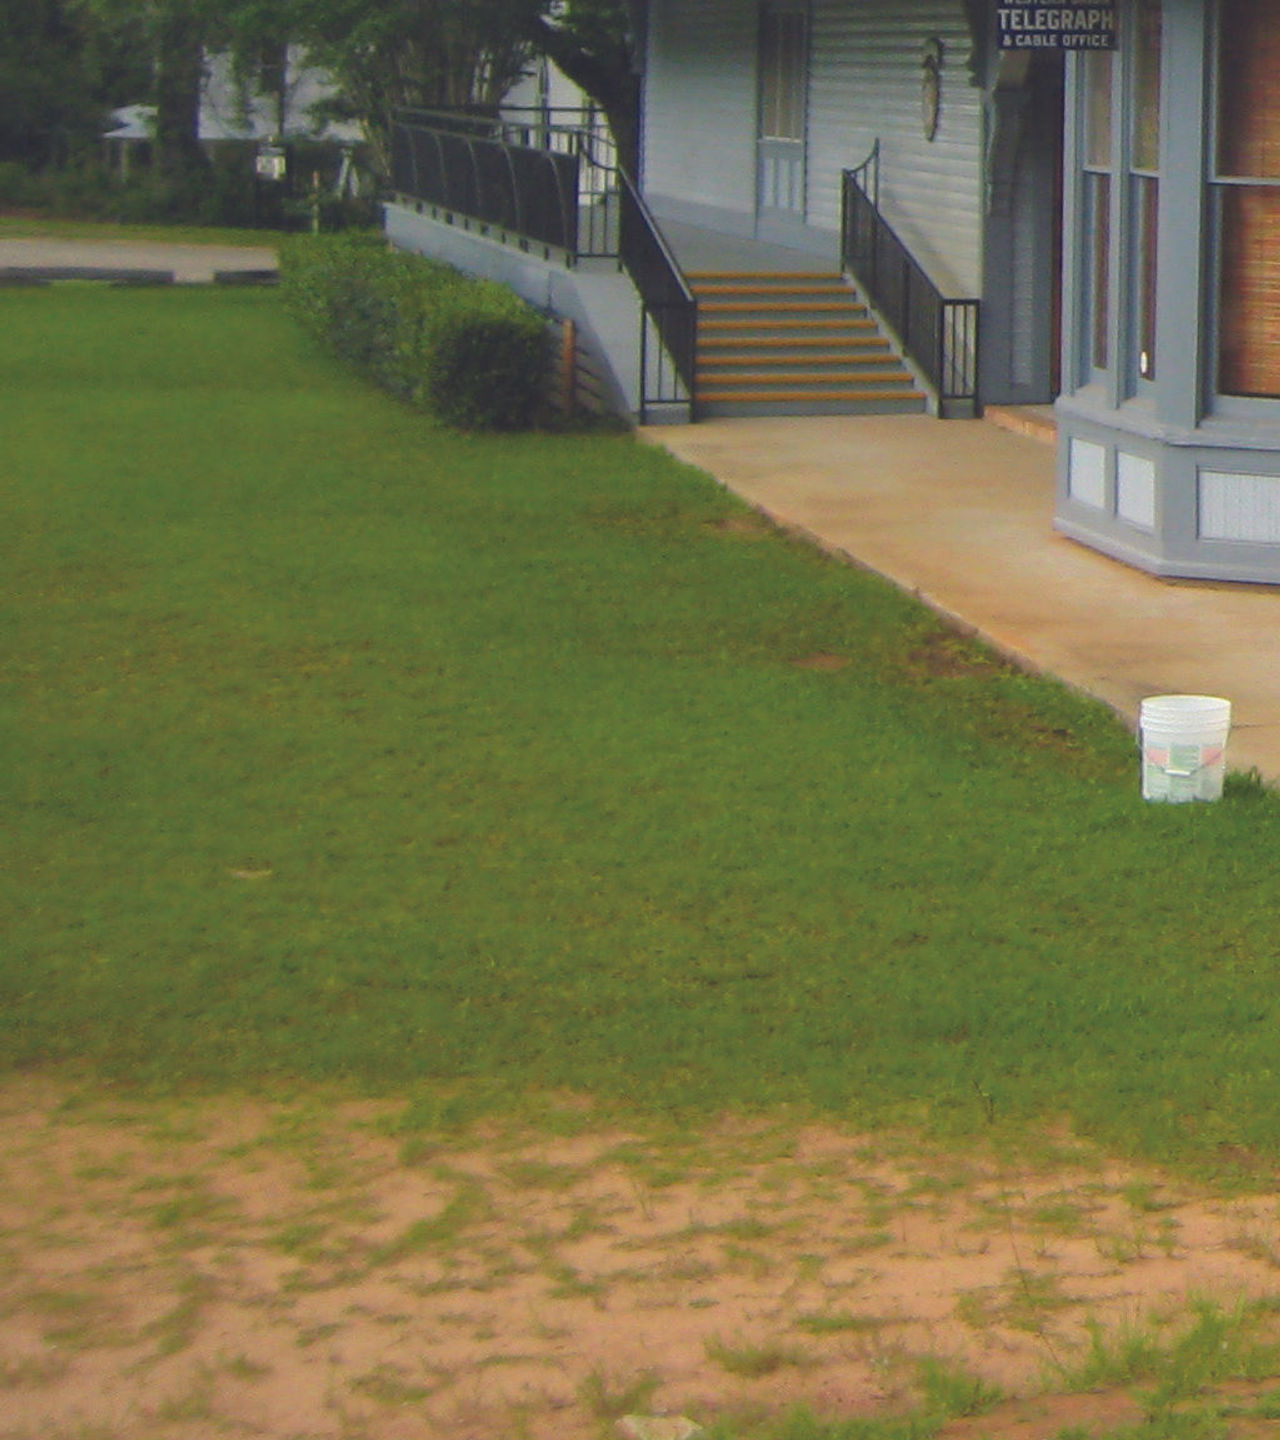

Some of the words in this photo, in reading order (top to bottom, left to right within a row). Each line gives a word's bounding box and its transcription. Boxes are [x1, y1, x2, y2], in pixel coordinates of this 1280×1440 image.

[997, 8, 1113, 30] TELEGRAPH
[1003, 34, 1012, 47] &
[1015, 34, 1057, 47] CABLE
[1062, 34, 1109, 47] OFFICE
